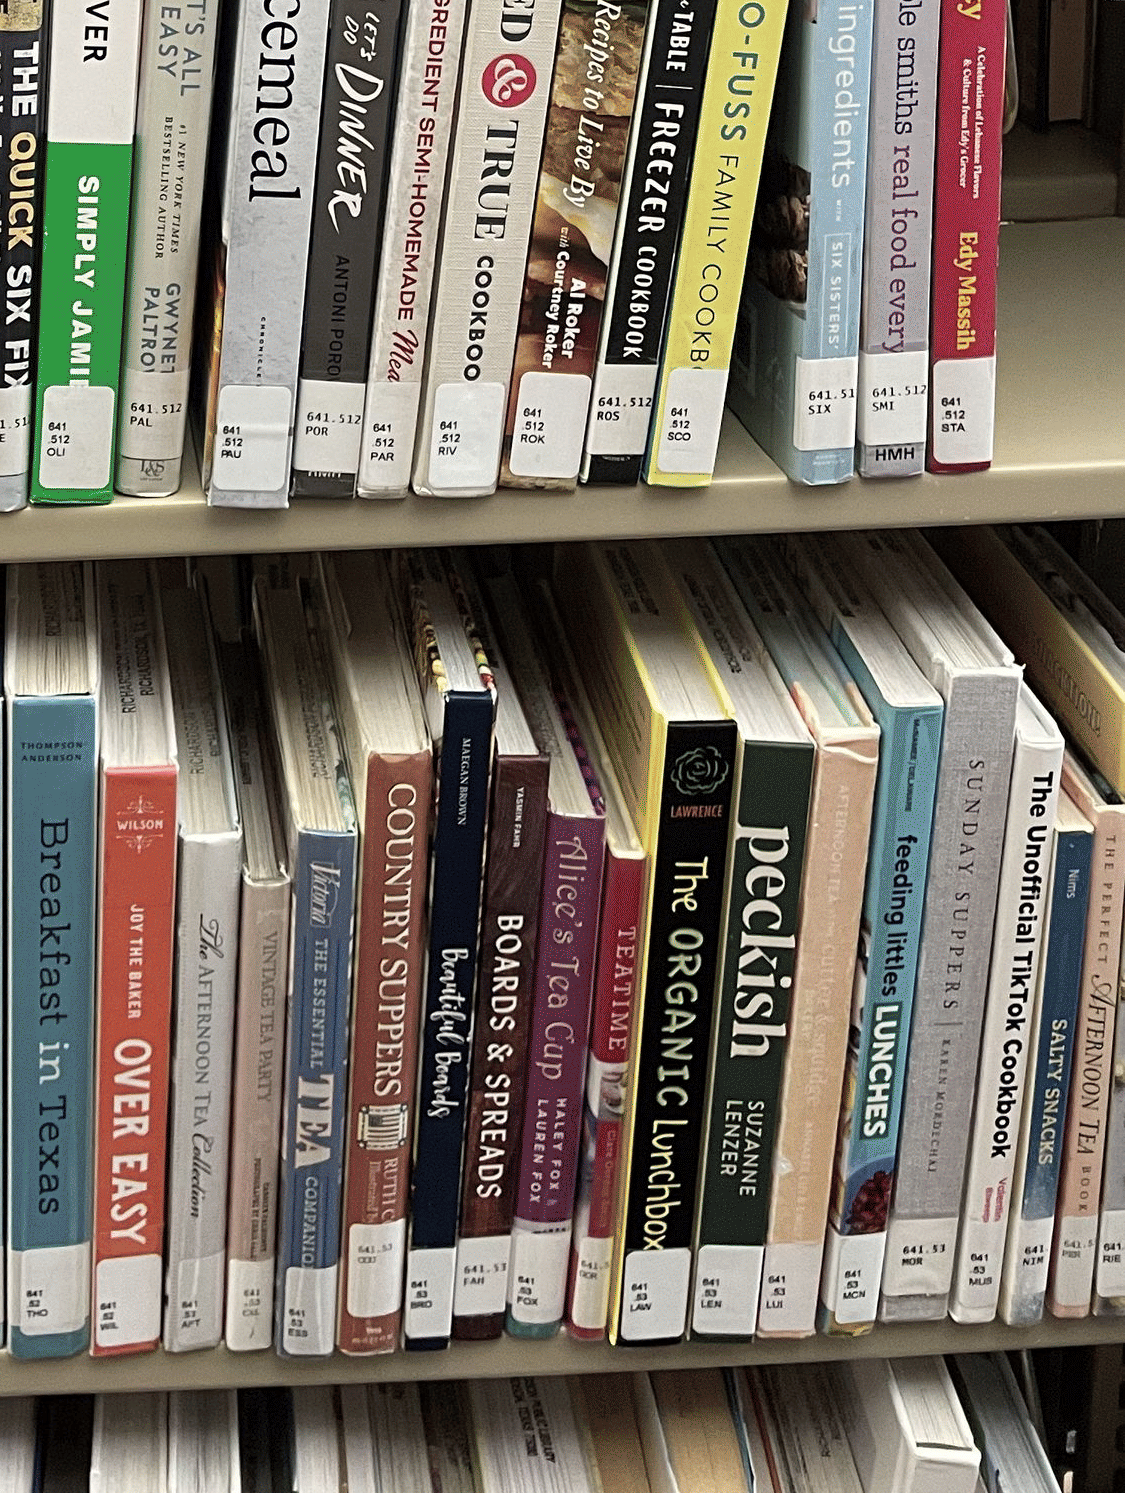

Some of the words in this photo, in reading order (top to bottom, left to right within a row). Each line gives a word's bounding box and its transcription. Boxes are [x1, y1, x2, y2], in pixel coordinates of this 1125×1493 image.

[894, 35, 917, 135] smiths
[892, 144, 918, 199] real
[47, 447, 65, 457] OLI
[49, 421, 67, 432] 641
[875, 448, 915, 461] HMH
[117, 818, 163, 831] WILSON
[1030, 771, 1053, 817] The
[38, 817, 70, 1026] Breakfast
[1016, 825, 1047, 946] Unofficial
[491, 914, 523, 1033] BOARDS
[730, 824, 795, 1060] peckish
[1007, 954, 1034, 1032] TikTok
[39, 1040, 67, 1083] in
[113, 1040, 152, 1139] OVER
[991, 1041, 1023, 1158] Cookbook
[38, 1095, 68, 1215] Texas
[477, 1071, 510, 1198] SPREADS
[721, 1100, 742, 1176] LENZER
[740, 1101, 765, 1197] SUZANNE
[111, 1154, 149, 1244] EASY
